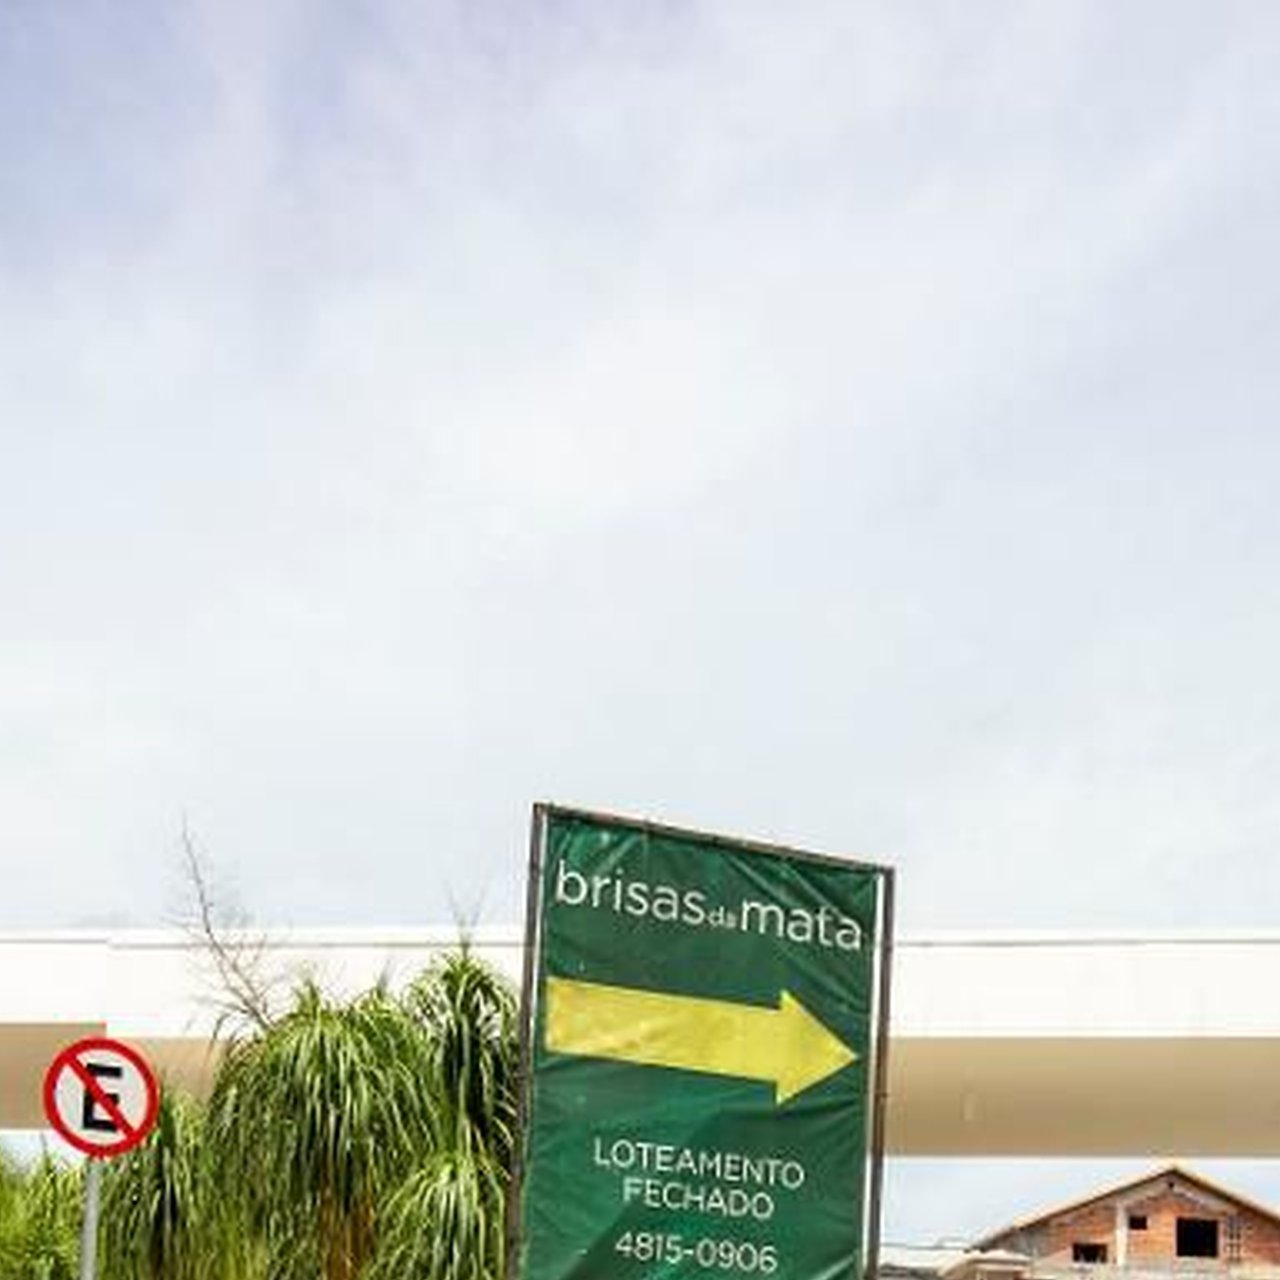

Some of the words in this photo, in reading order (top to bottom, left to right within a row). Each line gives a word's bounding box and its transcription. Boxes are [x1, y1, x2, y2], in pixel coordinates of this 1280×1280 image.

[555, 858, 707, 925] brisas
[740, 898, 863, 951] mata
[82, 1062, 123, 1132] E
[593, 1137, 806, 1189] LOTEAMENTO
[622, 1177, 774, 1219] FECHADO
[615, 1231, 779, 1273] 4815-0906
